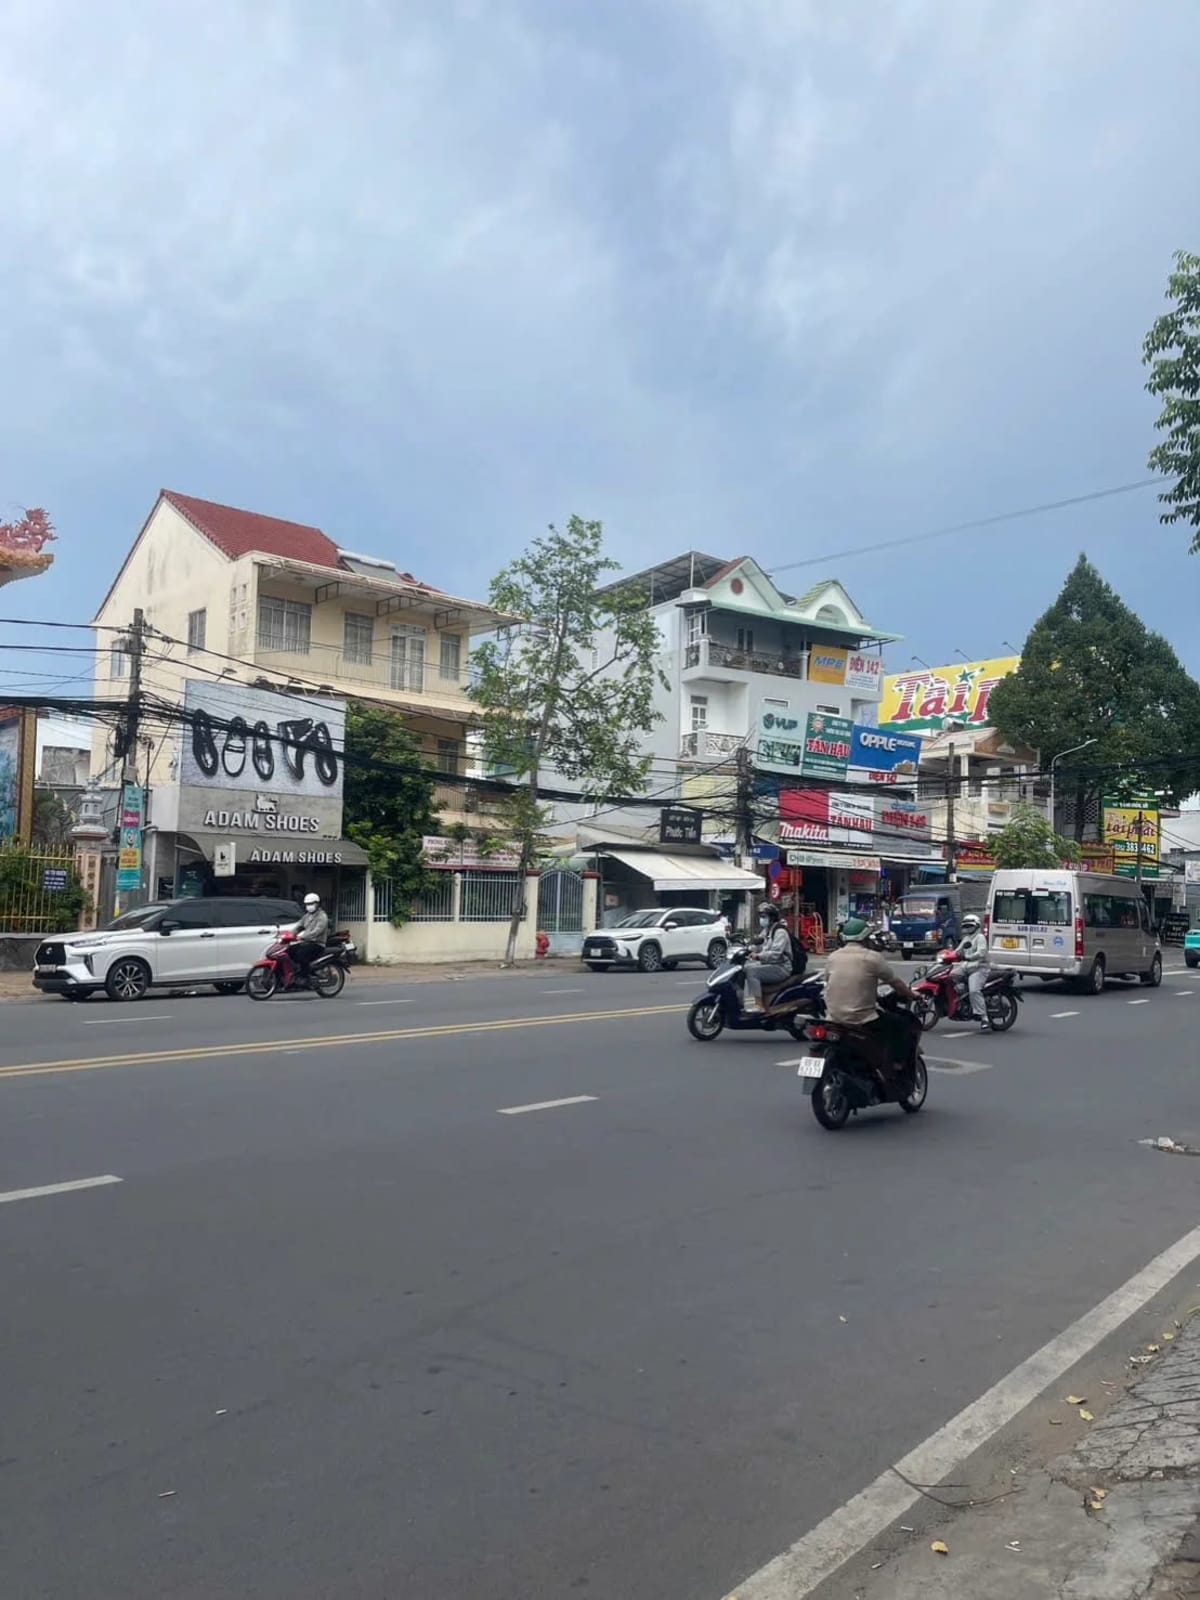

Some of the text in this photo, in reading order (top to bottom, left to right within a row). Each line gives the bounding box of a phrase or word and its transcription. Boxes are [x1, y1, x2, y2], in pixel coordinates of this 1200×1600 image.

[860, 732, 897, 752] OPPLE
[204, 810, 321, 833] ADAM SHOES
[250, 850, 342, 864] ADAM SHOES
